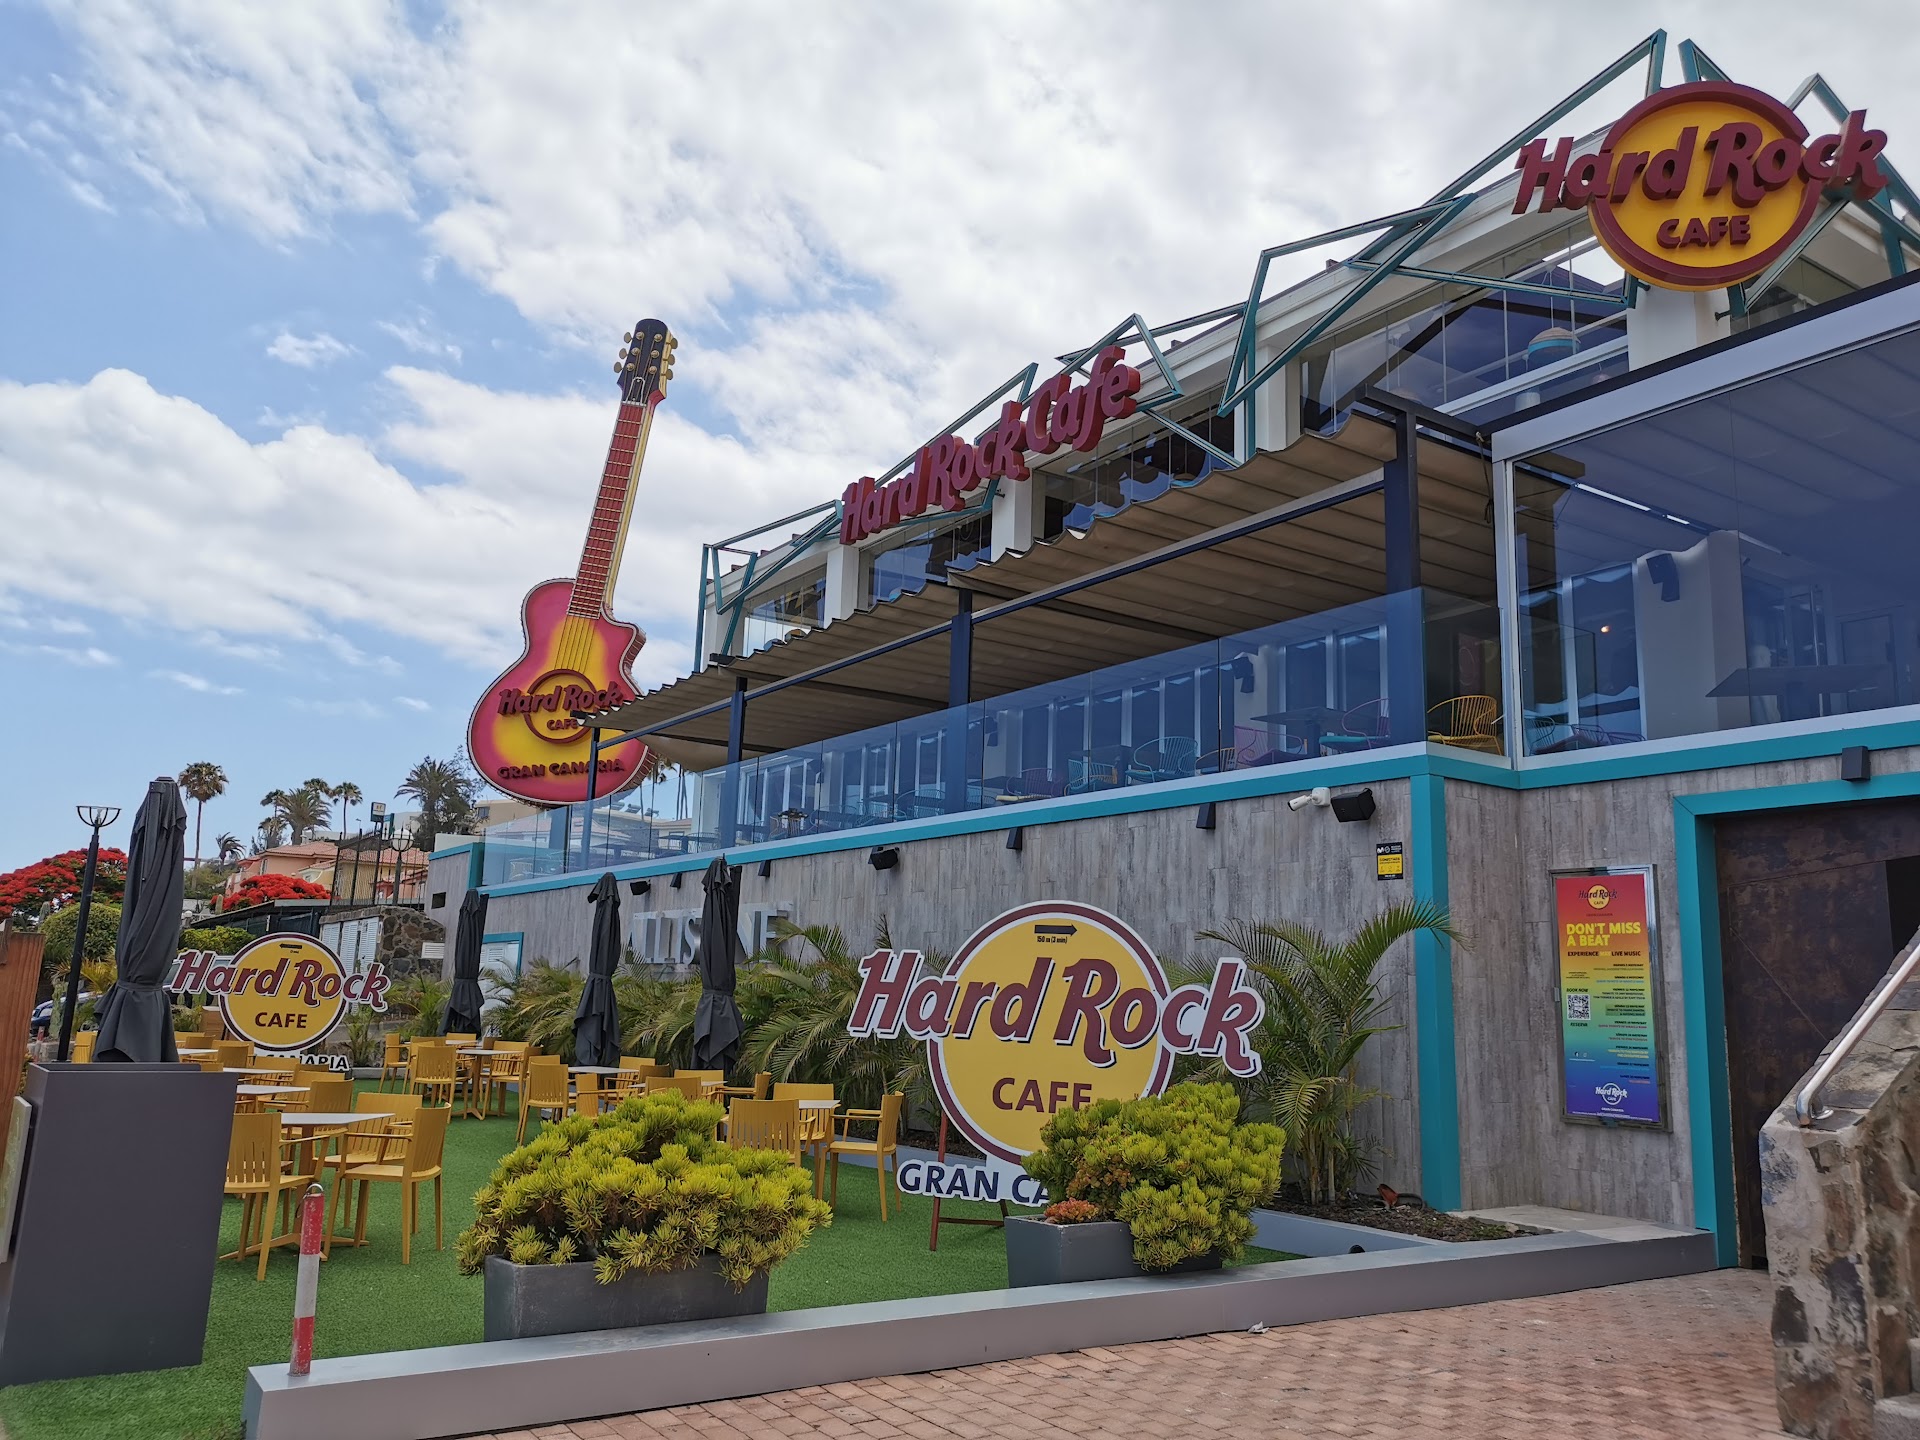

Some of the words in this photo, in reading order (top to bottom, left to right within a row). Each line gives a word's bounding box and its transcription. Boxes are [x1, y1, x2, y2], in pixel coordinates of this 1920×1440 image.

[1511, 125, 1699, 215] Hard
[1703, 108, 1889, 208] Rock
[1656, 214, 1751, 250] CAFE
[839, 446, 932, 546] Hard
[927, 400, 1030, 513] Rock
[1025, 345, 1141, 455] Cafe
[497, 685, 563, 717] Hard
[563, 681, 624, 712] Rock
[546, 718, 578, 731] CAFE
[497, 764, 546, 780] GRAN
[1579, 889, 1598, 899] Hard
[1599, 889, 1618, 899] Rock
[1566, 923, 1606, 935] DON'T
[1609, 922, 1641, 934] MISS
[1566, 935, 1577, 947] A
[1580, 935, 1611, 947] BEAT
[171, 950, 291, 995] Hard
[288, 959, 391, 1012] Rock
[254, 1012, 308, 1029] CAFE
[848, 949, 1056, 1041] Hard
[1053, 957, 1264, 1077] Rock
[1595, 1087, 1611, 1095] Hard
[1611, 1088, 1628, 1098] Rock
[900, 1163, 1000, 1201] GRAN
